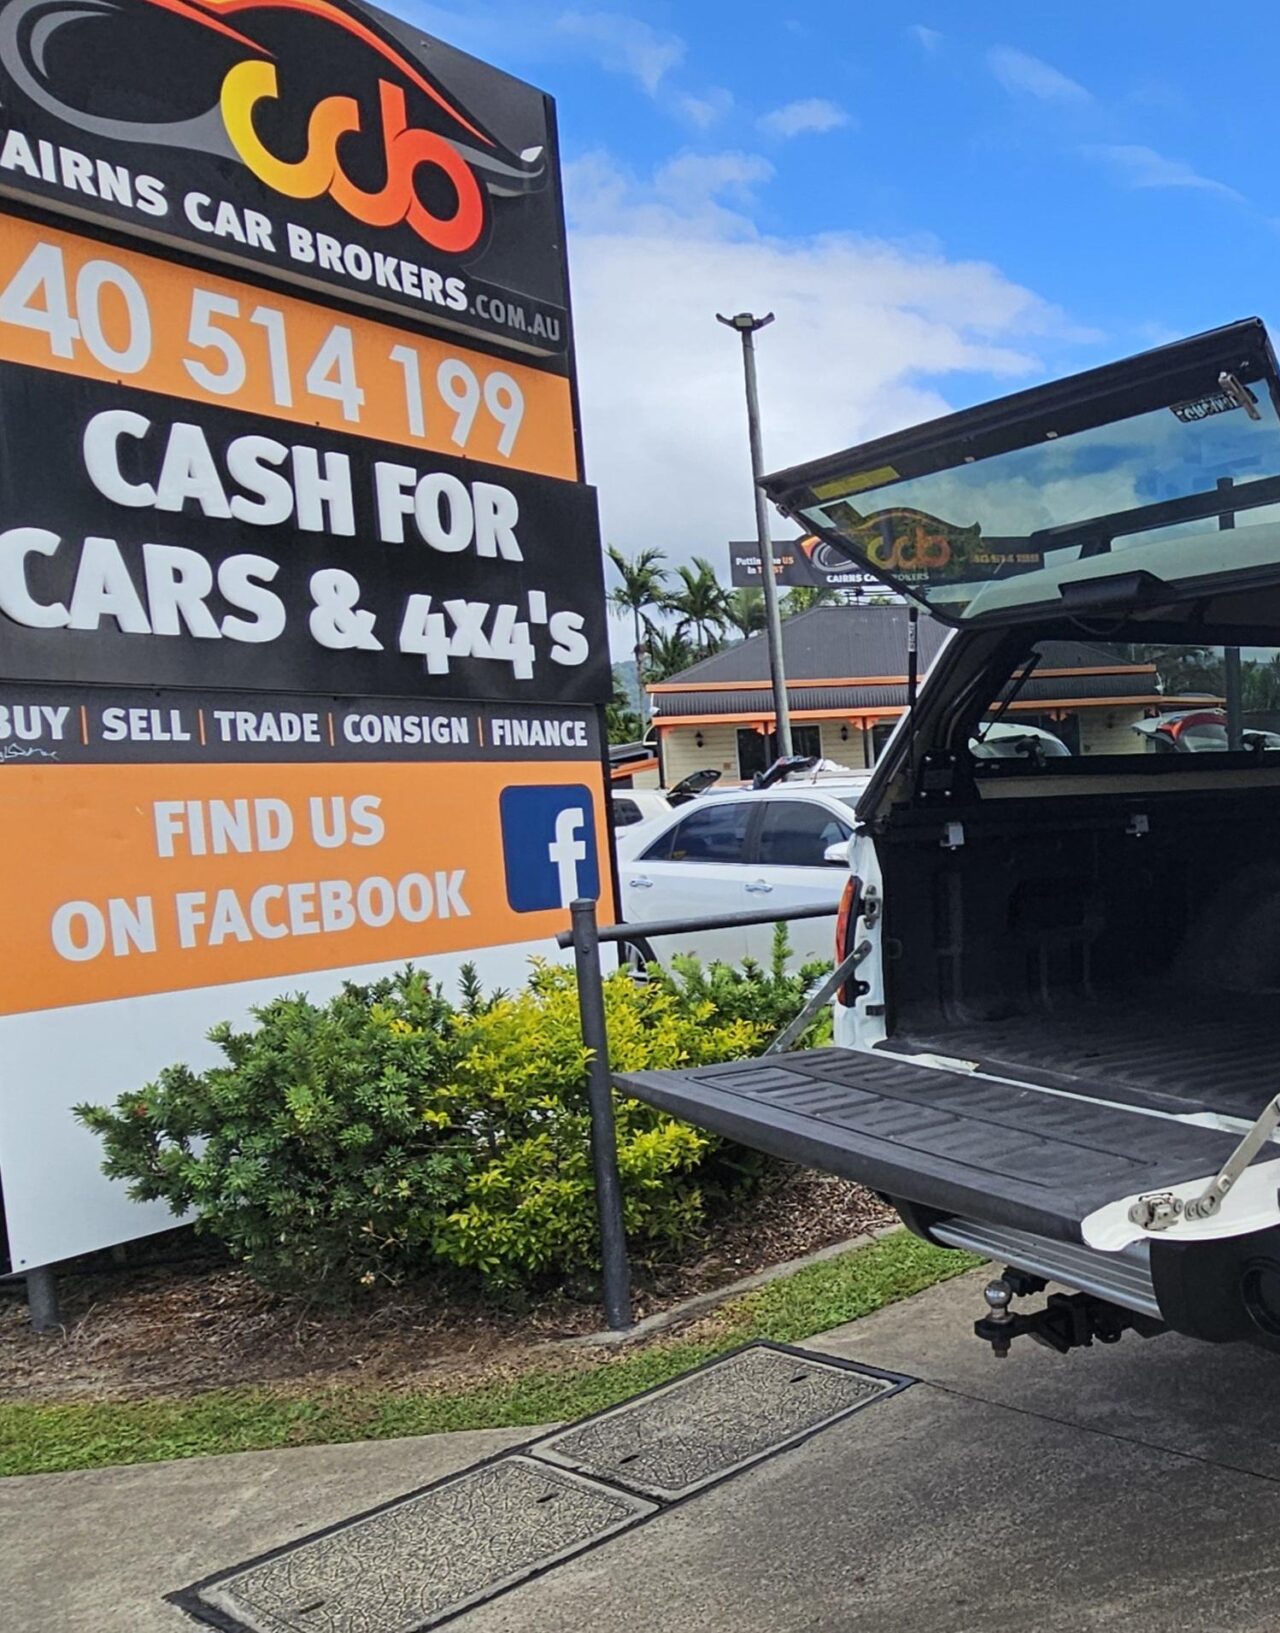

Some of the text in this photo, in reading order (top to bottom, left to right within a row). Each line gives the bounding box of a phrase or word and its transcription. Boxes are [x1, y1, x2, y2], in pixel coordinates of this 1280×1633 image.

[184, 191, 276, 253] CAR
[0, 241, 525, 459] 40 514 199
[83, 409, 524, 562] CASH FOR
[0, 527, 287, 643] CARS
[309, 568, 384, 651] &
[735, 557, 762, 566] Puttin
[782, 556, 795, 565] US
[826, 574, 862, 583] CAIRNS
[102, 707, 191, 742] SELL
[213, 709, 321, 743] TRADE
[342, 713, 470, 744] CONSIGN
[491, 717, 588, 747] FINANCE
[153, 795, 386, 858] FIND US
[51, 869, 471, 962] ON FACEBOOK
